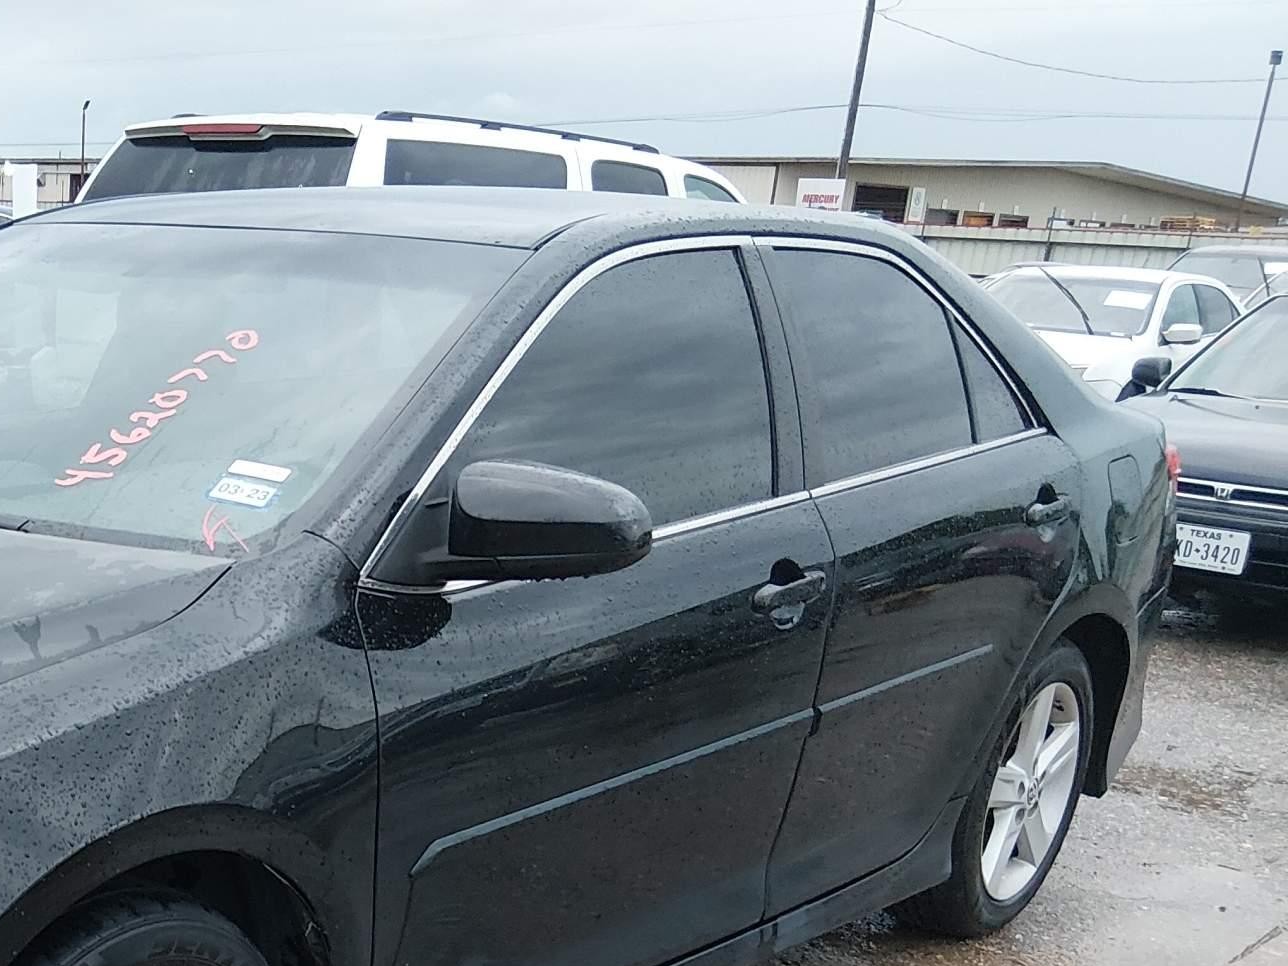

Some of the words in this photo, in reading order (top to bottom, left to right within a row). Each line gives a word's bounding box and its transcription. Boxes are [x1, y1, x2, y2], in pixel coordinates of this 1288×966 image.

[802, 193, 840, 204] MERCURY
[54, 328, 259, 486] 45620770
[1190, 528, 1223, 541] TEXAS
